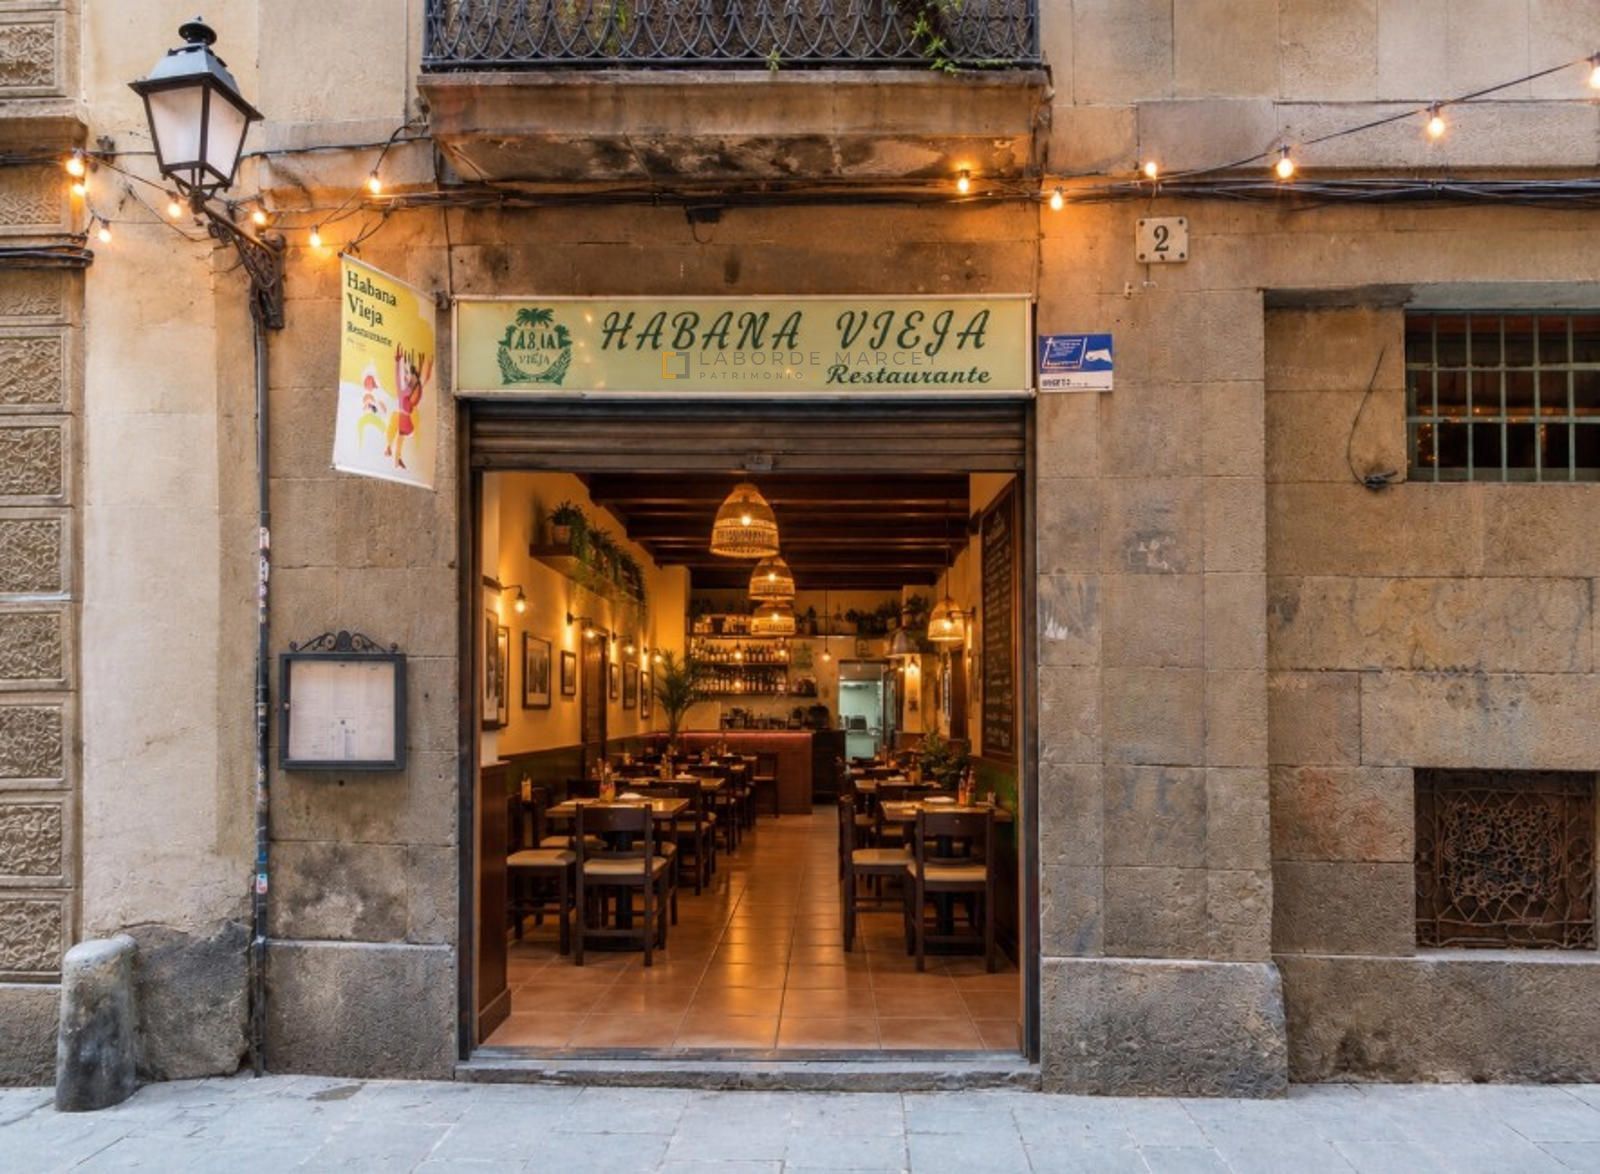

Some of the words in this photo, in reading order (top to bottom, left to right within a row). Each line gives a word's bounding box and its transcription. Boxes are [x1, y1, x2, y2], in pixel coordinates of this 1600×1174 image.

[1153, 225, 1169, 252] 2
[347, 270, 397, 306] Habana
[346, 292, 383, 327] Vieja
[601, 310, 802, 351] HABANA
[836, 309, 990, 357] VIEJA
[825, 363, 992, 385] Restaurante
